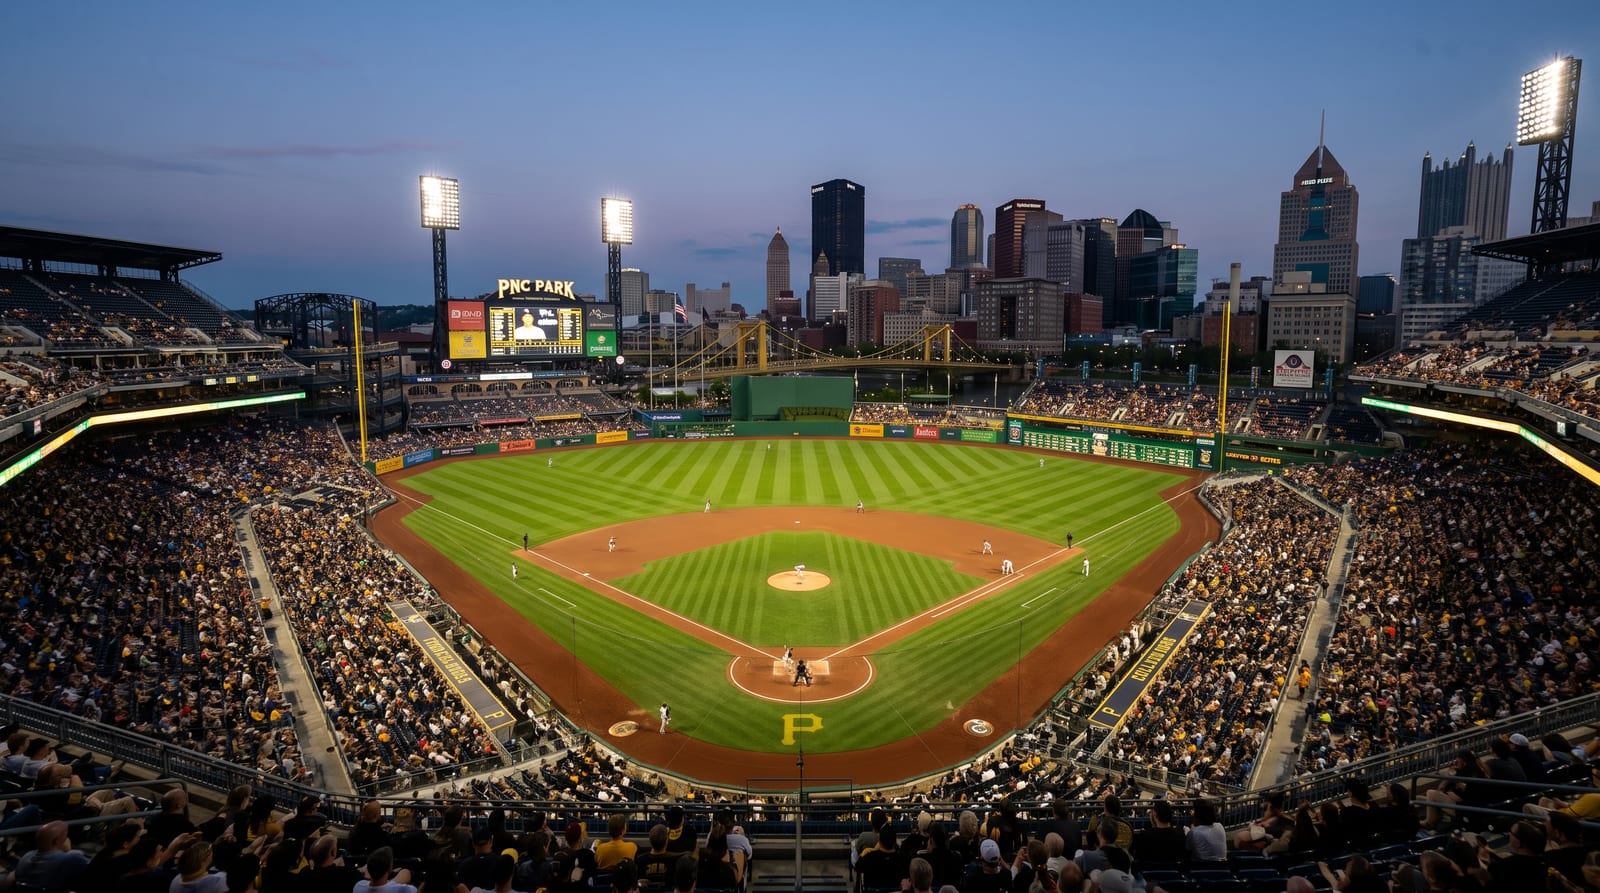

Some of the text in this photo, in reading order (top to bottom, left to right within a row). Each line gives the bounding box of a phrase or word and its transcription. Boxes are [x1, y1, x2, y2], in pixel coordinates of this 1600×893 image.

[497, 279, 576, 301] PNC PARK
[781, 713, 824, 746] P
